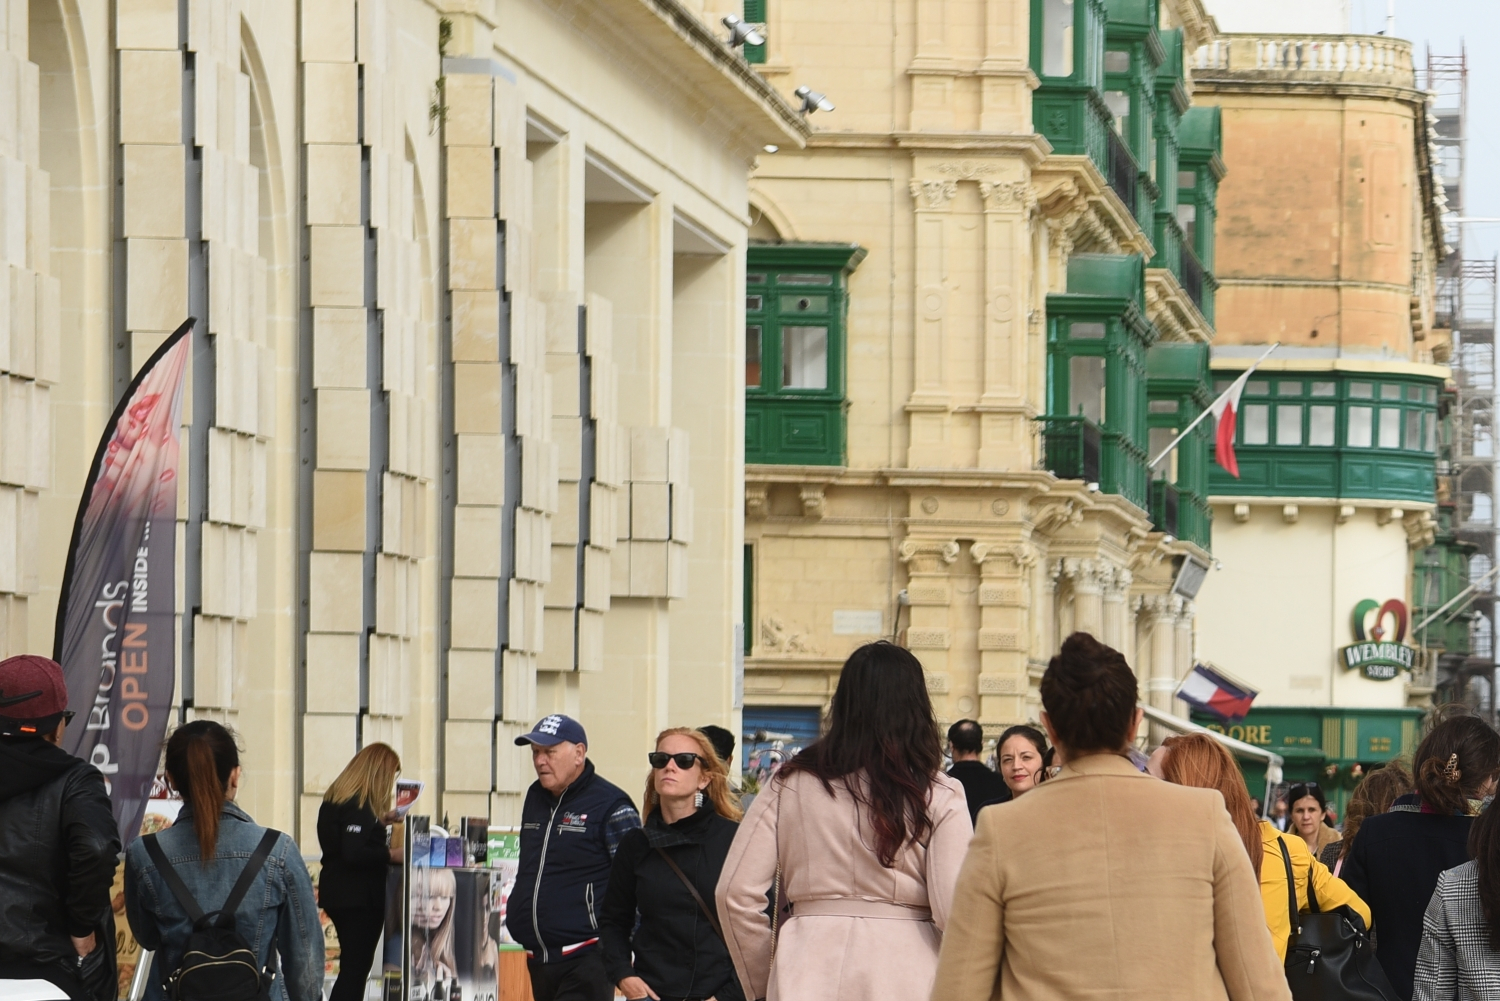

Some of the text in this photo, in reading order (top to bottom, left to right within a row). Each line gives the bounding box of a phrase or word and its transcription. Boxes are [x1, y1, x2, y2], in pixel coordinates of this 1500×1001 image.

[132, 546, 149, 613] INSIDE
[87, 580, 129, 731] Brands
[121, 622, 148, 731] OPEN
[1346, 643, 1415, 668] WEMBLEY
[1366, 664, 1396, 678] STORE
